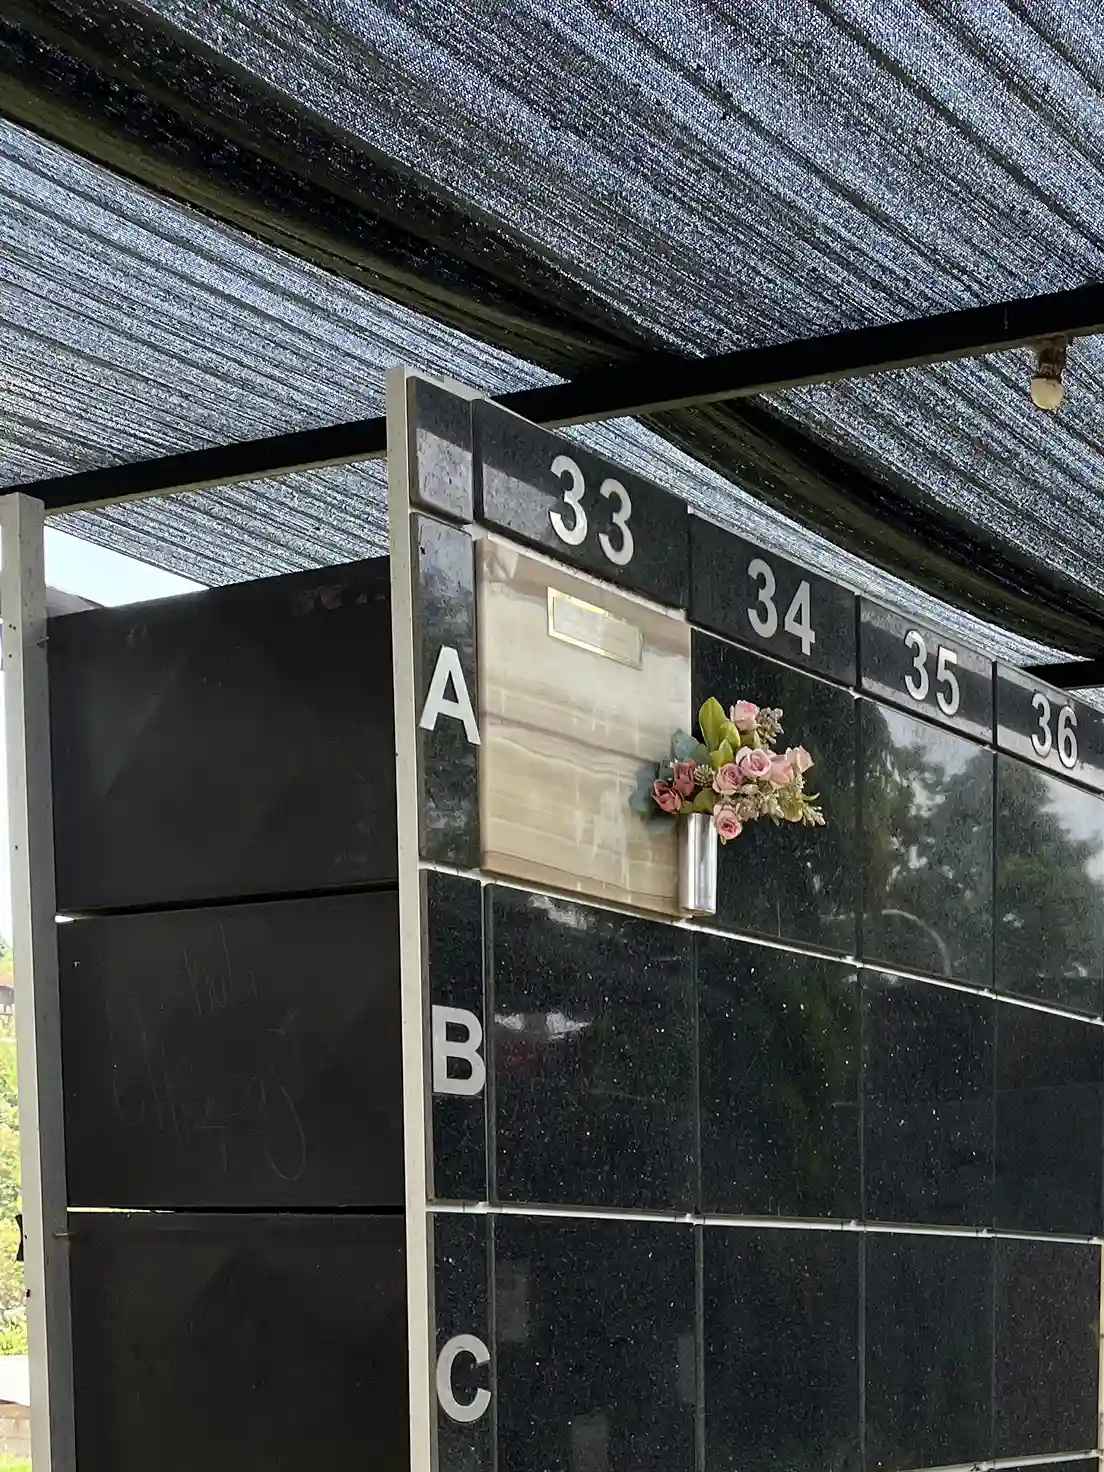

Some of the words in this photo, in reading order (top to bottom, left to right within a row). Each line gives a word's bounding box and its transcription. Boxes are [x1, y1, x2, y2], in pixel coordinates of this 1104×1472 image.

[549, 455, 634, 565] 33
[747, 558, 816, 656] 34
[419, 644, 482, 746] A
[904, 630, 960, 716] 35
[1031, 693, 1078, 769] 36
[431, 1004, 486, 1096] B
[436, 1333, 492, 1422] C
